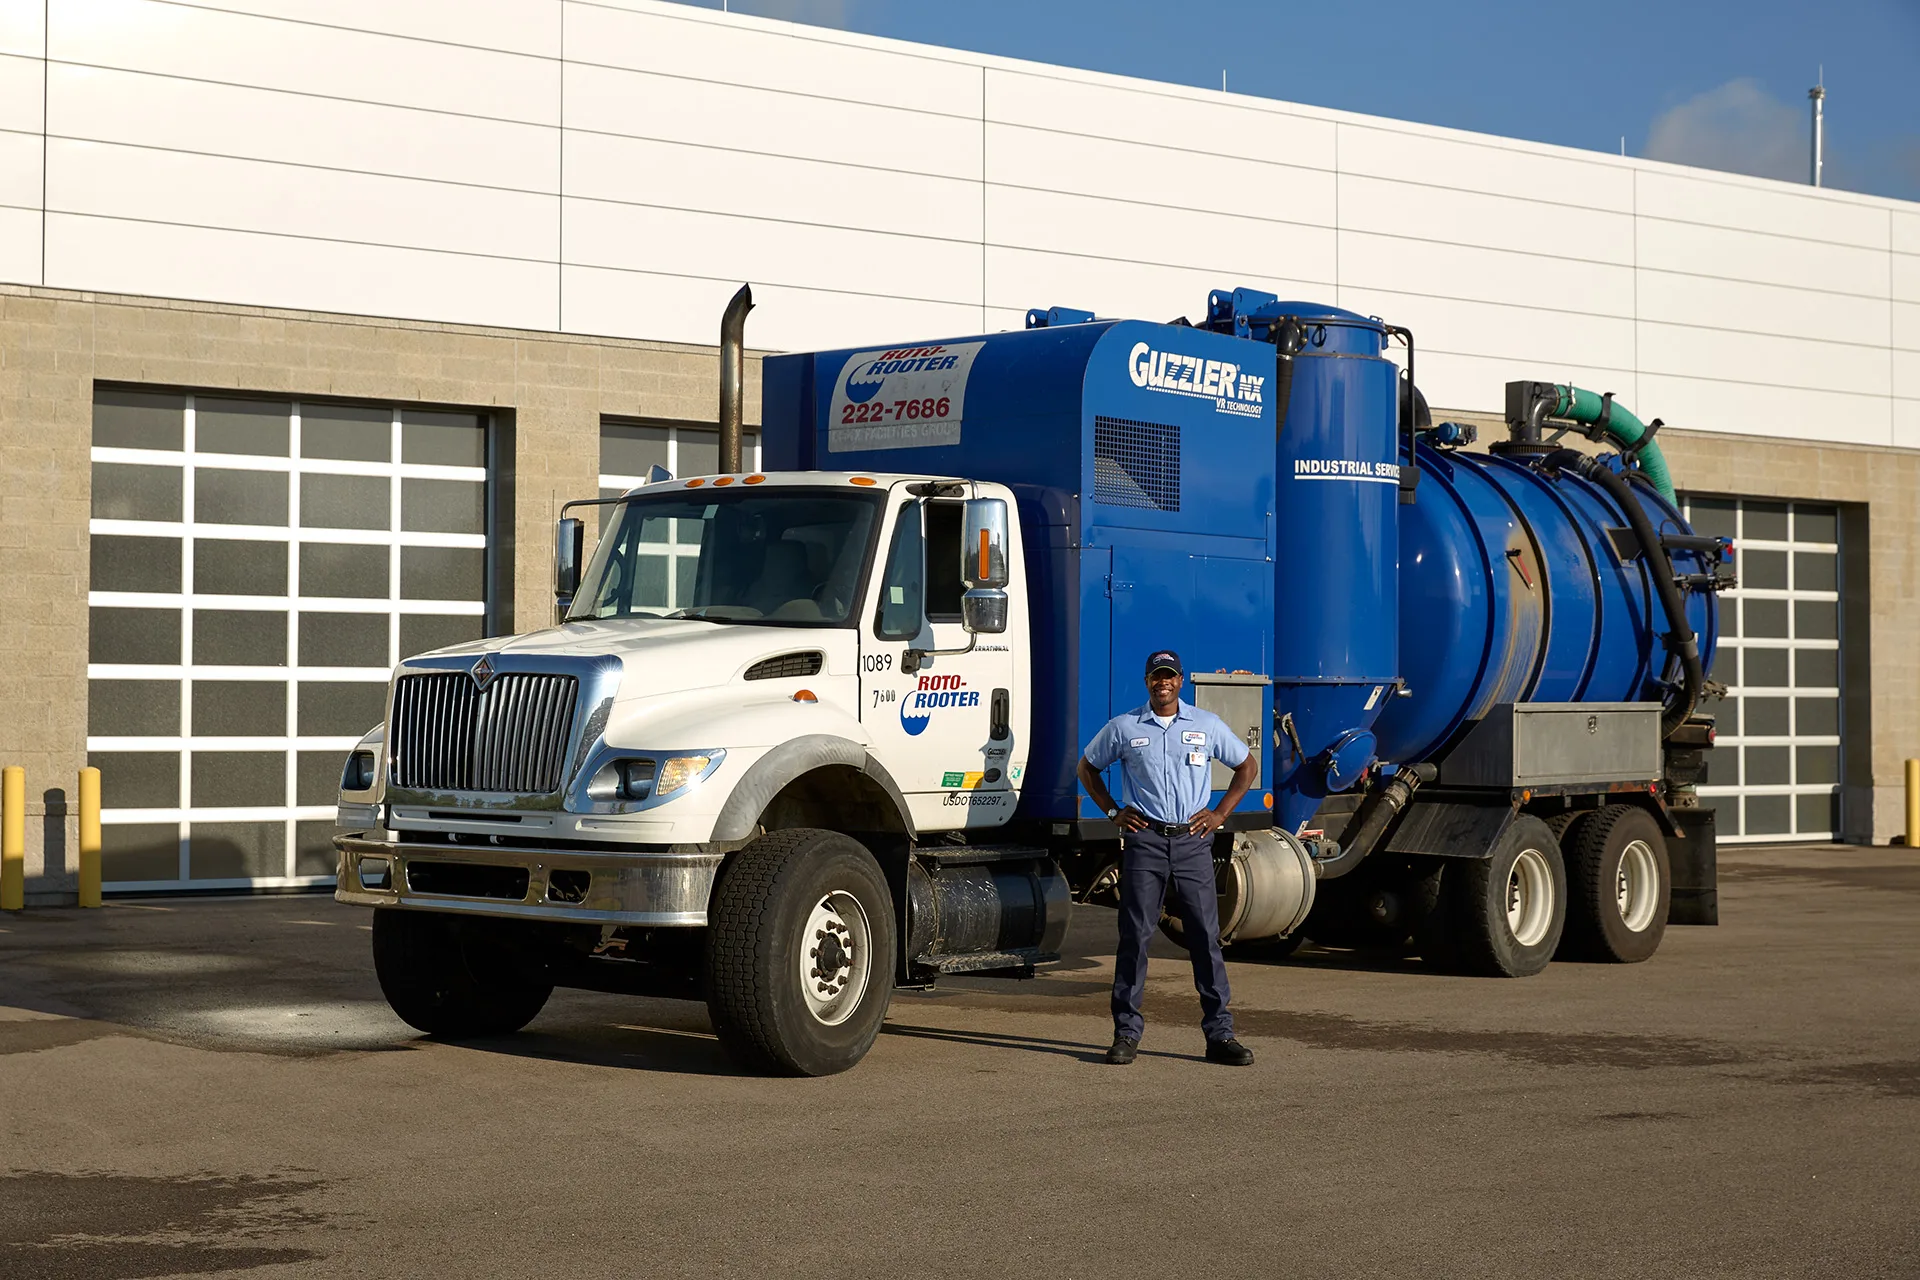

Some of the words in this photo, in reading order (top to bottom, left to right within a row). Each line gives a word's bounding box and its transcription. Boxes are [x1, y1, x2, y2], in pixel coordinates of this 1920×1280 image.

[866, 355, 959, 376] ROOTER
[1128, 341, 1238, 399] GUZZLER
[841, 396, 951, 425] 222-7686
[1216, 397, 1226, 409] VR
[1226, 400, 1263, 415] TECHNOLOGY
[1294, 459, 1374, 476] INDUSTRIAL
[862, 653, 893, 672] 1089
[917, 674, 967, 691] ROTO-
[914, 691, 980, 709] ROOTER
